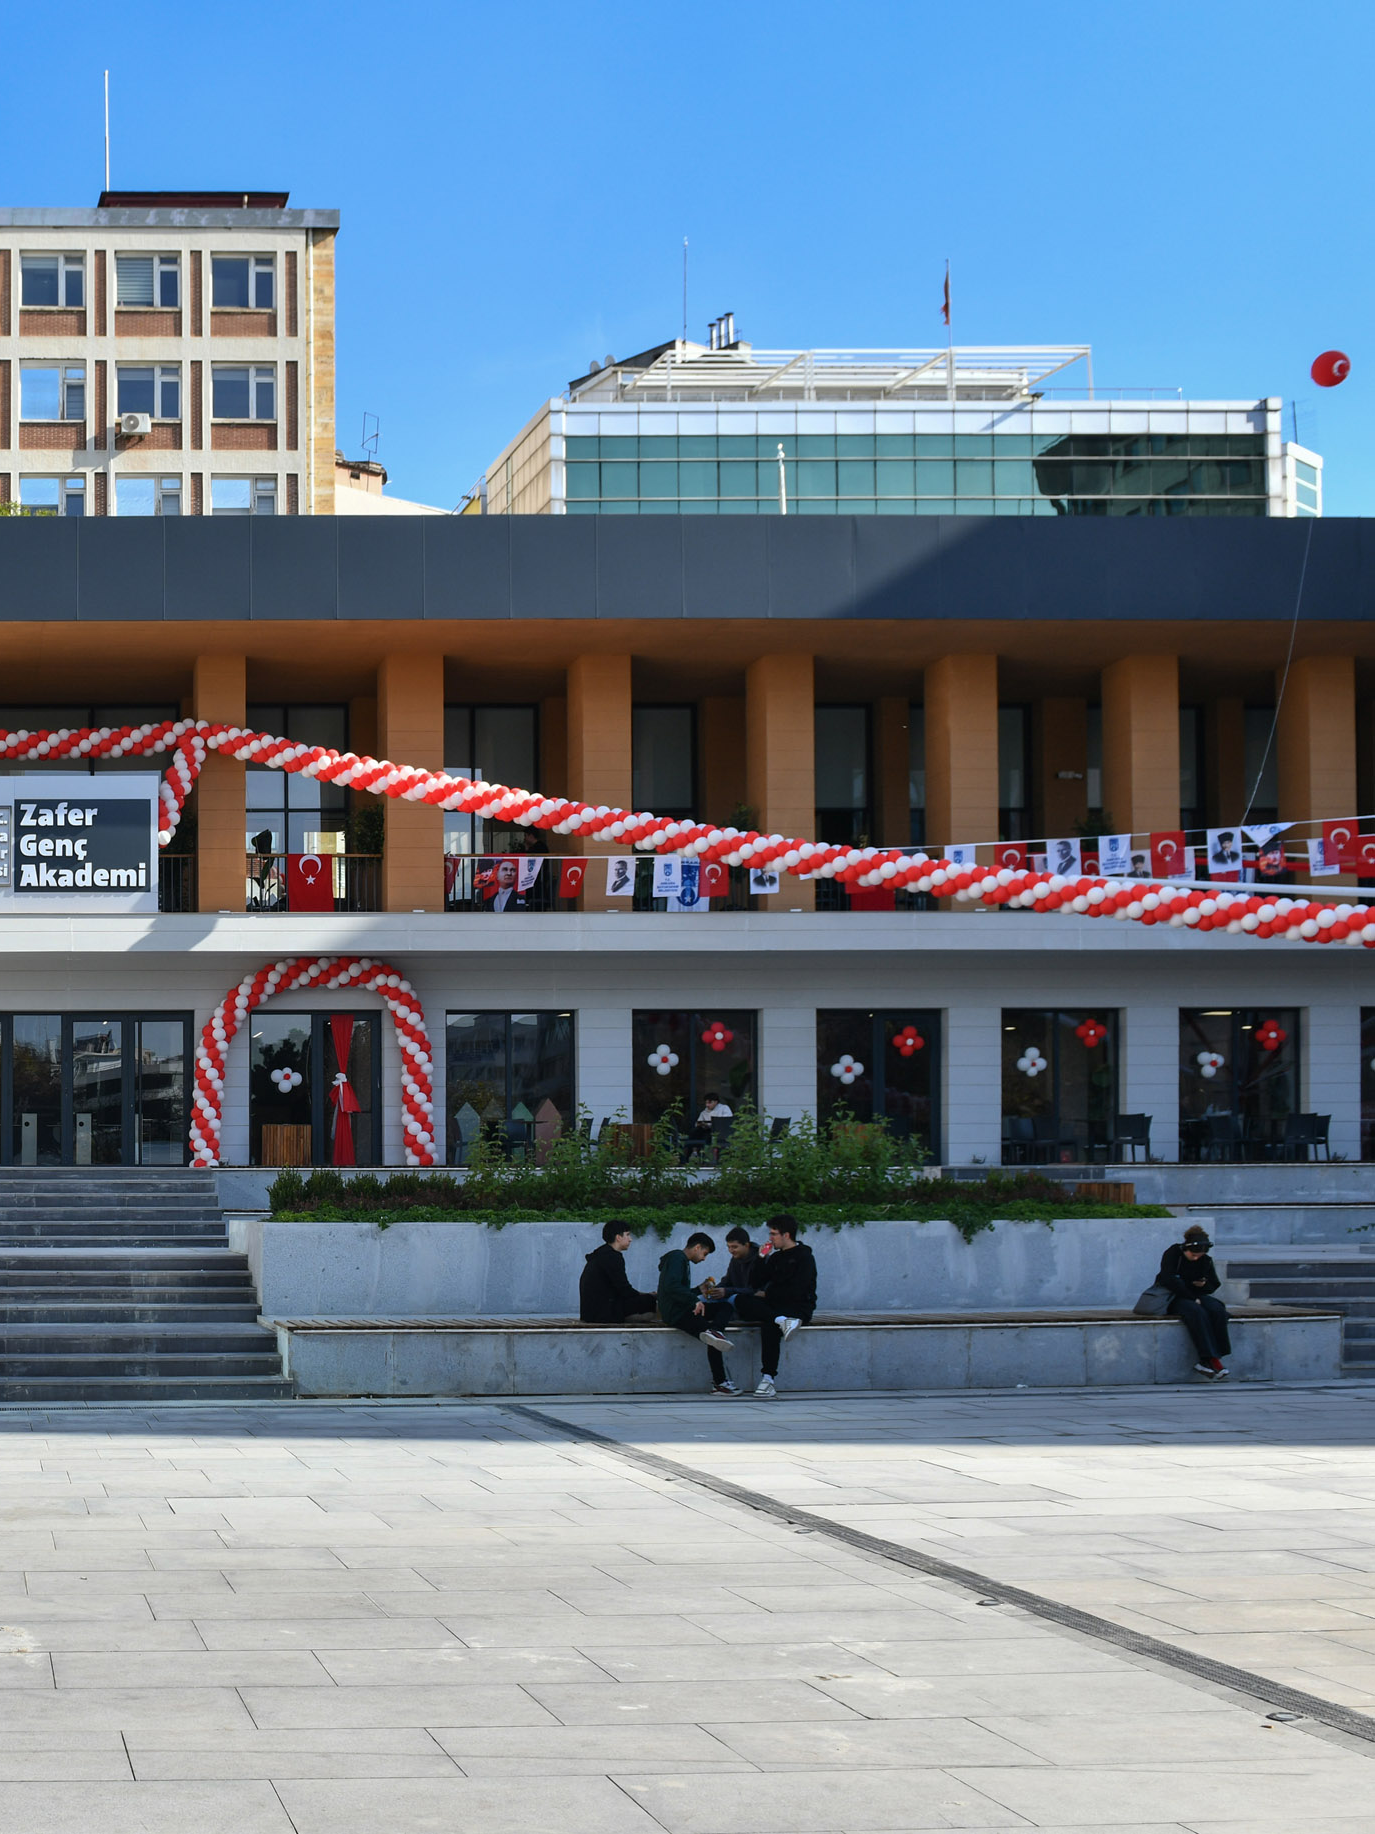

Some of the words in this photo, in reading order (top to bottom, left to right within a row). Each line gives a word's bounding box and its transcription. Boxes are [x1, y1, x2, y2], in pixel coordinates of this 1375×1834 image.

[19, 802, 99, 826] Zafer
[19, 834, 88, 860] Genç
[19, 862, 146, 887] Akademi
